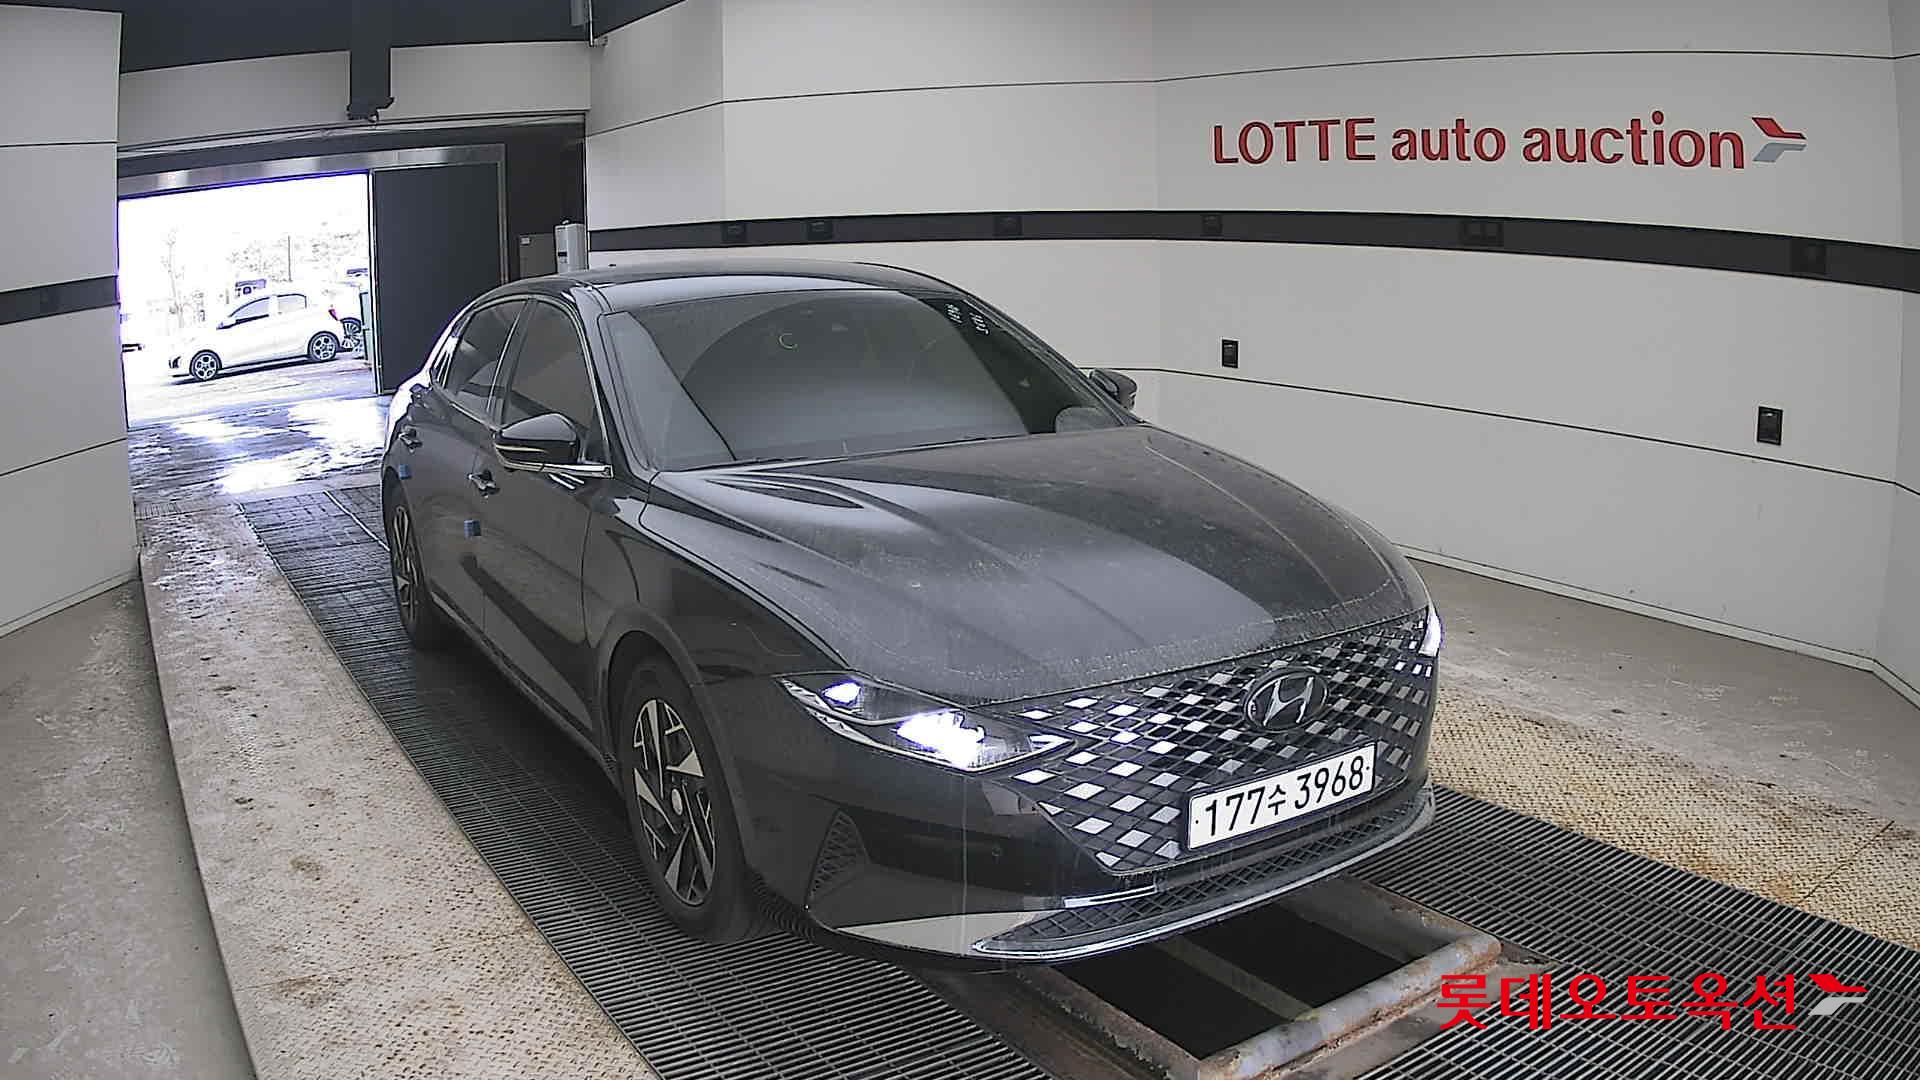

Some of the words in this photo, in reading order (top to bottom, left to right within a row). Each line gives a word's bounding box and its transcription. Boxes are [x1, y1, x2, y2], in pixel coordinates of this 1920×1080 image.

[1213, 117, 1376, 164] LOTTE
[1391, 117, 1507, 162] auto
[1522, 110, 1746, 170] auction
[1294, 755, 1364, 810] 3968
